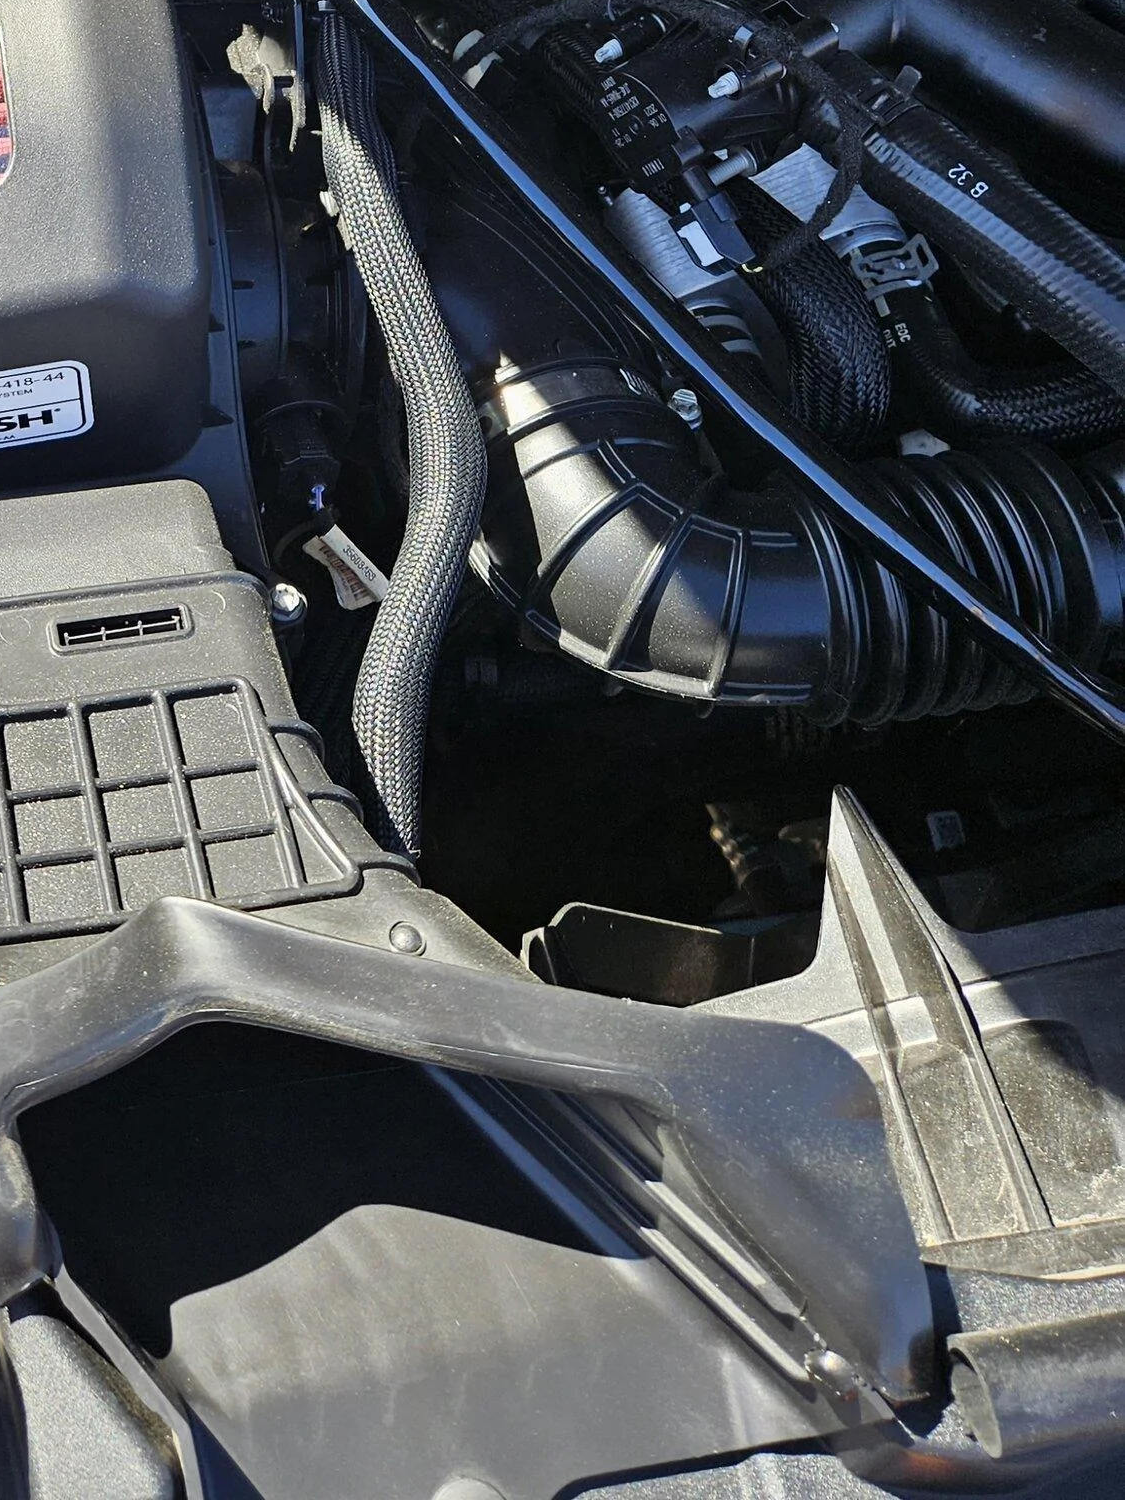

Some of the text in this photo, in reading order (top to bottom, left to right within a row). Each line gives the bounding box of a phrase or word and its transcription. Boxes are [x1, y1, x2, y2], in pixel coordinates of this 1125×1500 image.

[948, 163, 989, 199] B 32
[894, 322, 912, 343] EOC
